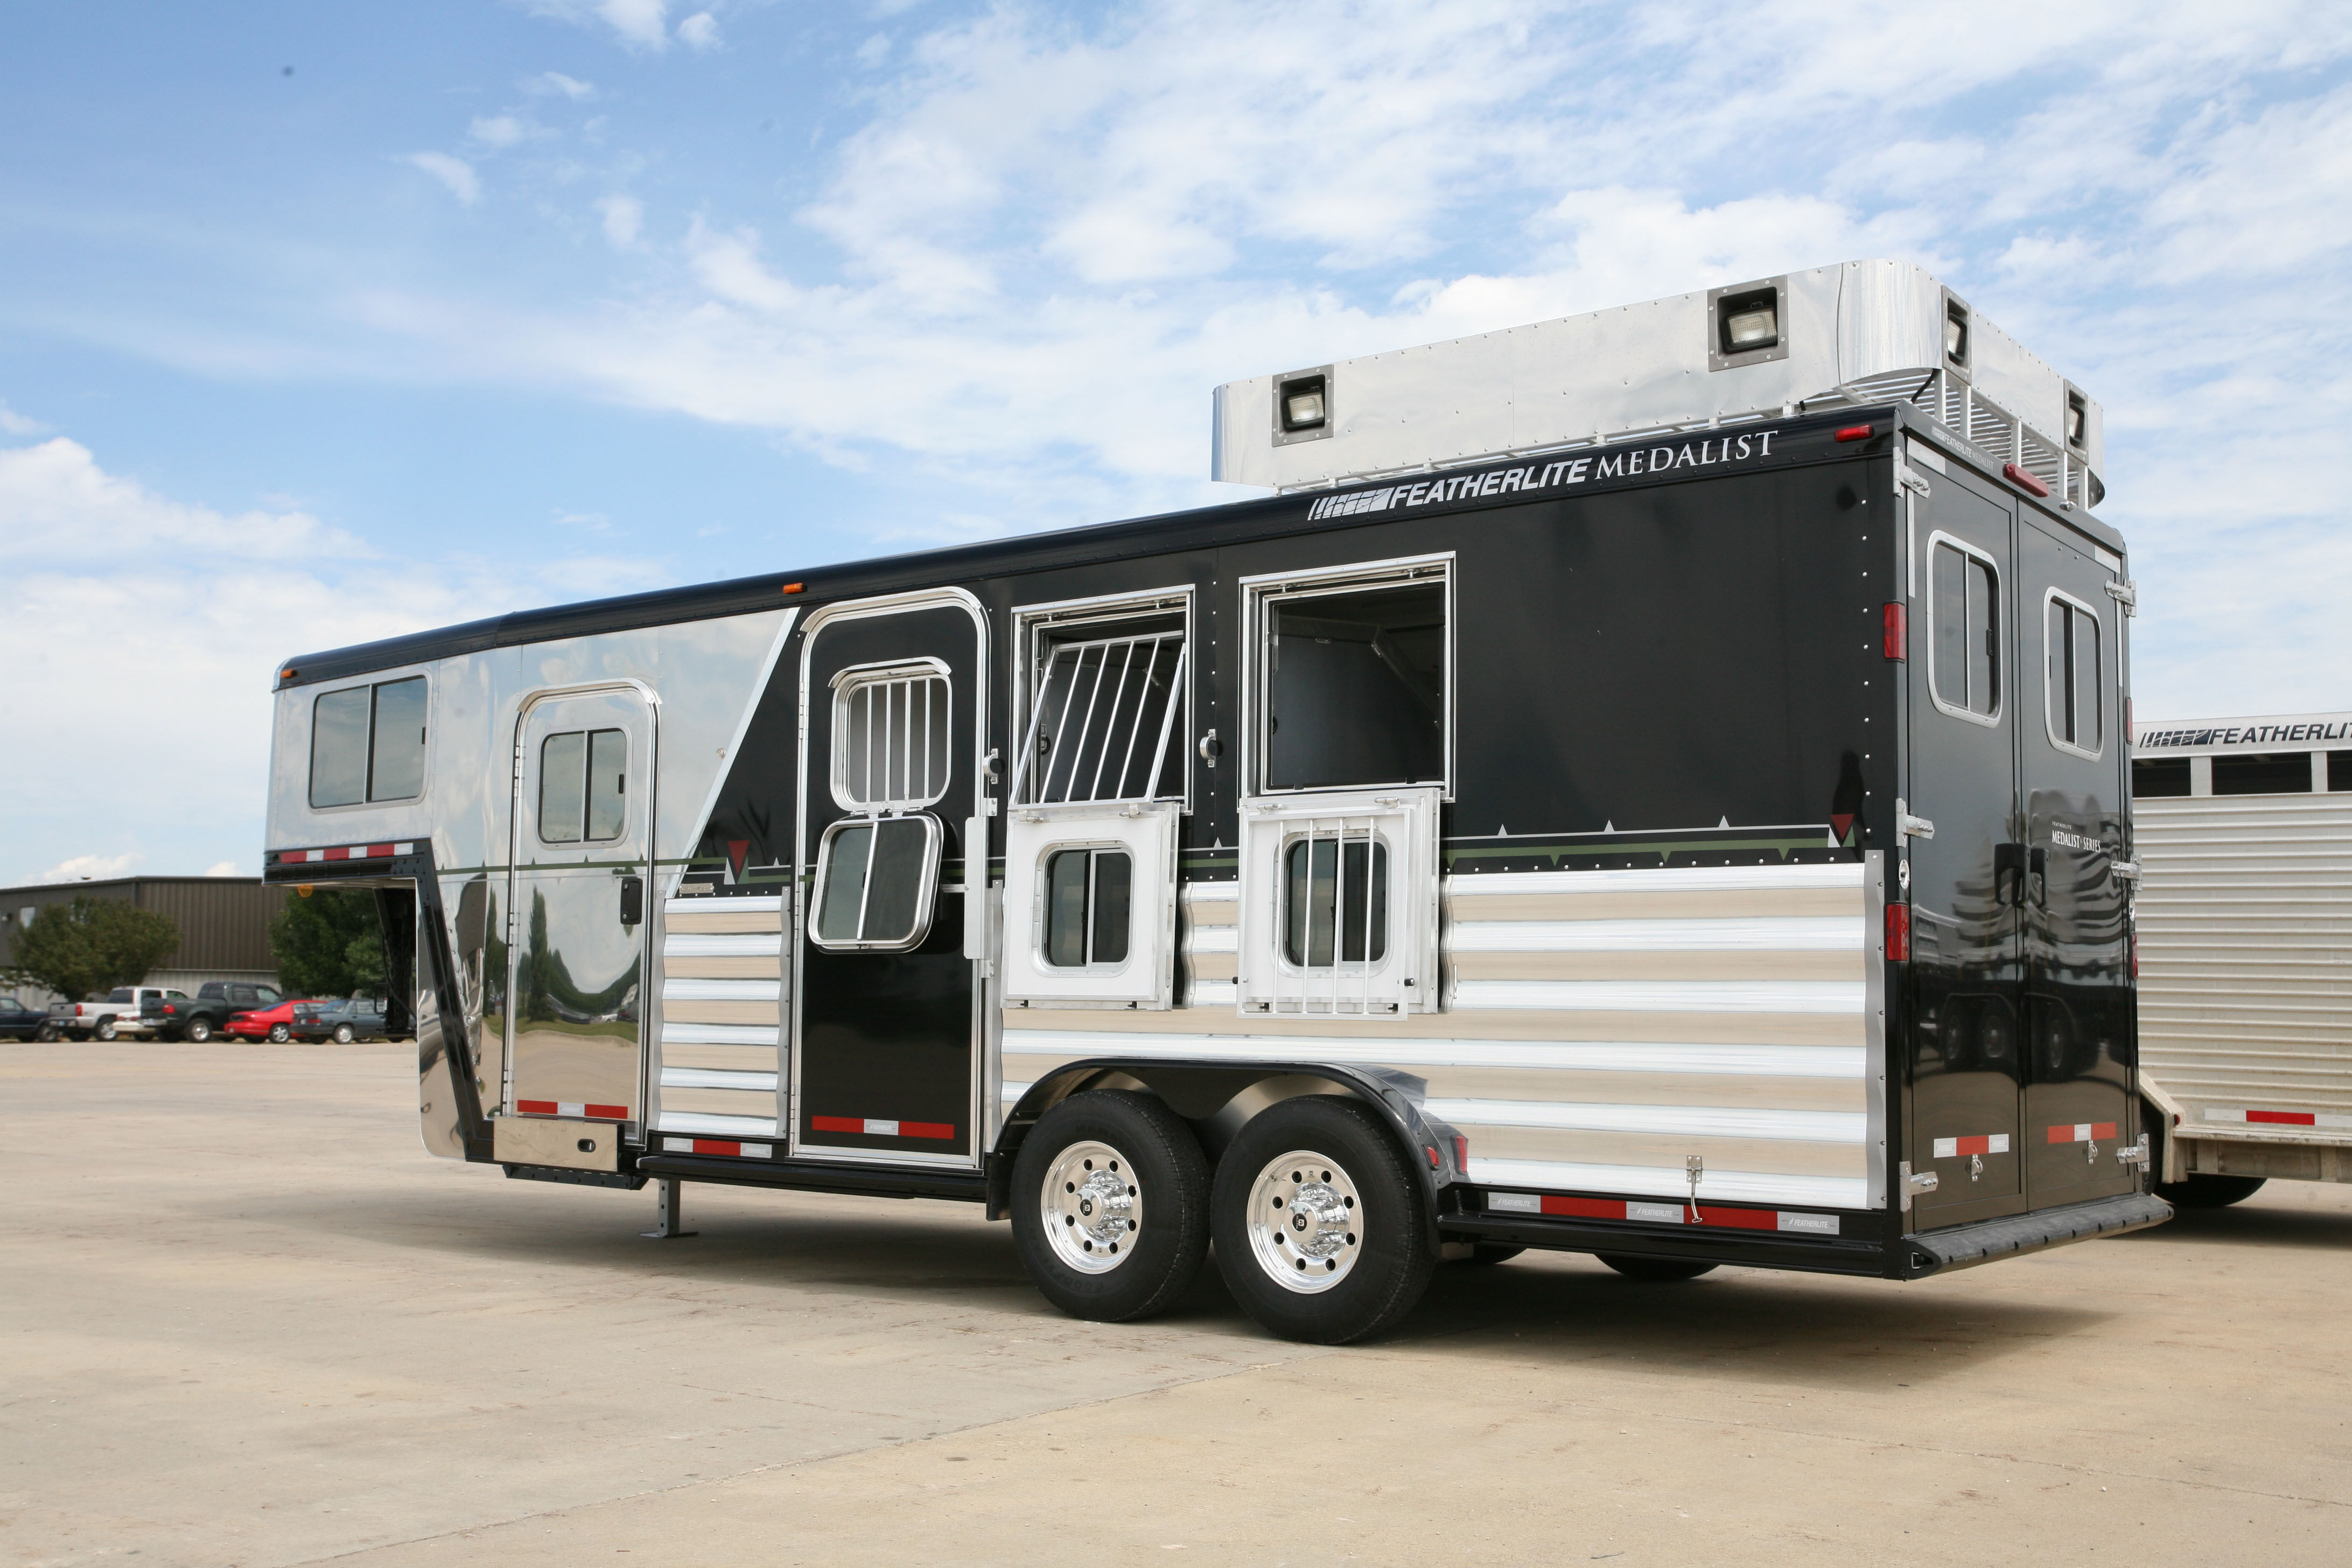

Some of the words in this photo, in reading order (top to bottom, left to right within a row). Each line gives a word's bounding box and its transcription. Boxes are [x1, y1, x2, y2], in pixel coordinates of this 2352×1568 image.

[1944, 434, 1972, 458] FEATHERLITE
[1972, 451, 1994, 470] MEDALIST
[1389, 457, 1593, 509] FEATHERLITE
[1594, 430, 1779, 480] MEDALIST
[2208, 723, 2352, 745] FEATHERLI
[2052, 821, 2072, 830] FEATHERLITE
[2052, 830, 2080, 849] MEDALIST
[2083, 837, 2101, 853] SERIES
[1501, 1199, 1531, 1207] FEATHERLITE
[1641, 1208, 1673, 1217] FEATHERLITE
[1794, 1219, 1829, 1228] FEATHERLITE
